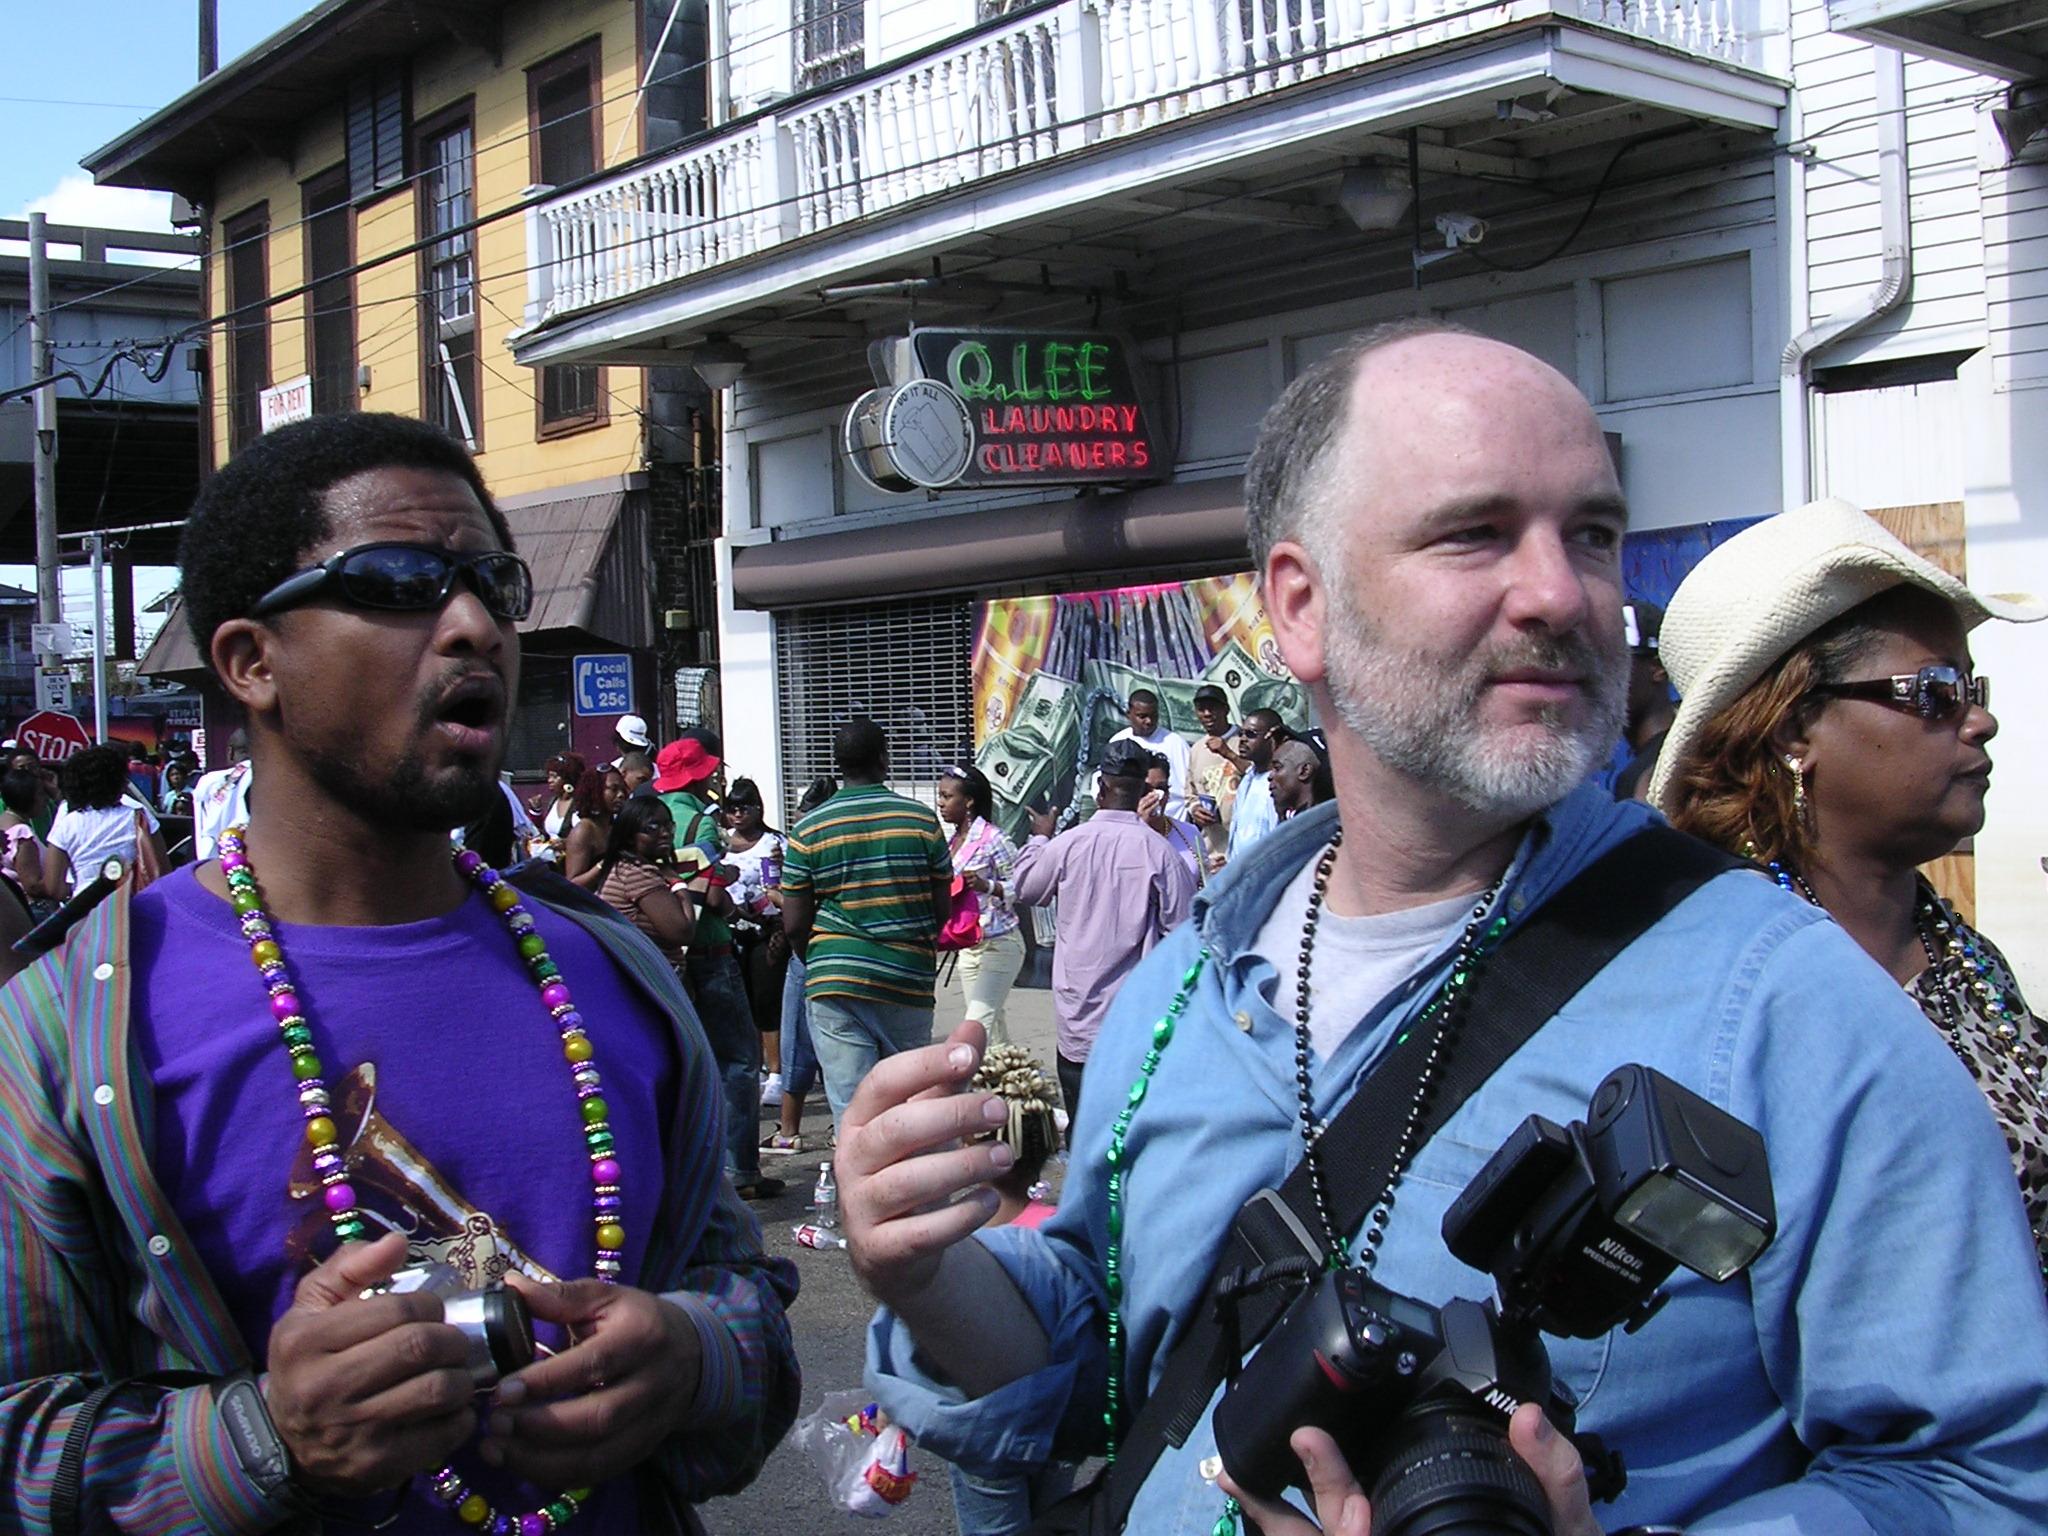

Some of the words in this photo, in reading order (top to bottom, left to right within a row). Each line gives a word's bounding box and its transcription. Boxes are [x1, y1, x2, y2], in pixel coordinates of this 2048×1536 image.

[1012, 341, 1112, 401] LEE
[268, 393, 285, 419] FOR
[910, 386, 919, 397] IT
[923, 387, 939, 401] ALL
[981, 404, 1138, 435] LAUNDRY
[977, 440, 1149, 475] CLEANERS
[594, 662, 627, 674] Local
[596, 677, 626, 689] Calls
[23, 729, 84, 762] STOP
[1598, 1237, 1643, 1270] Nikon
[1484, 1388, 1521, 1416] Nik
